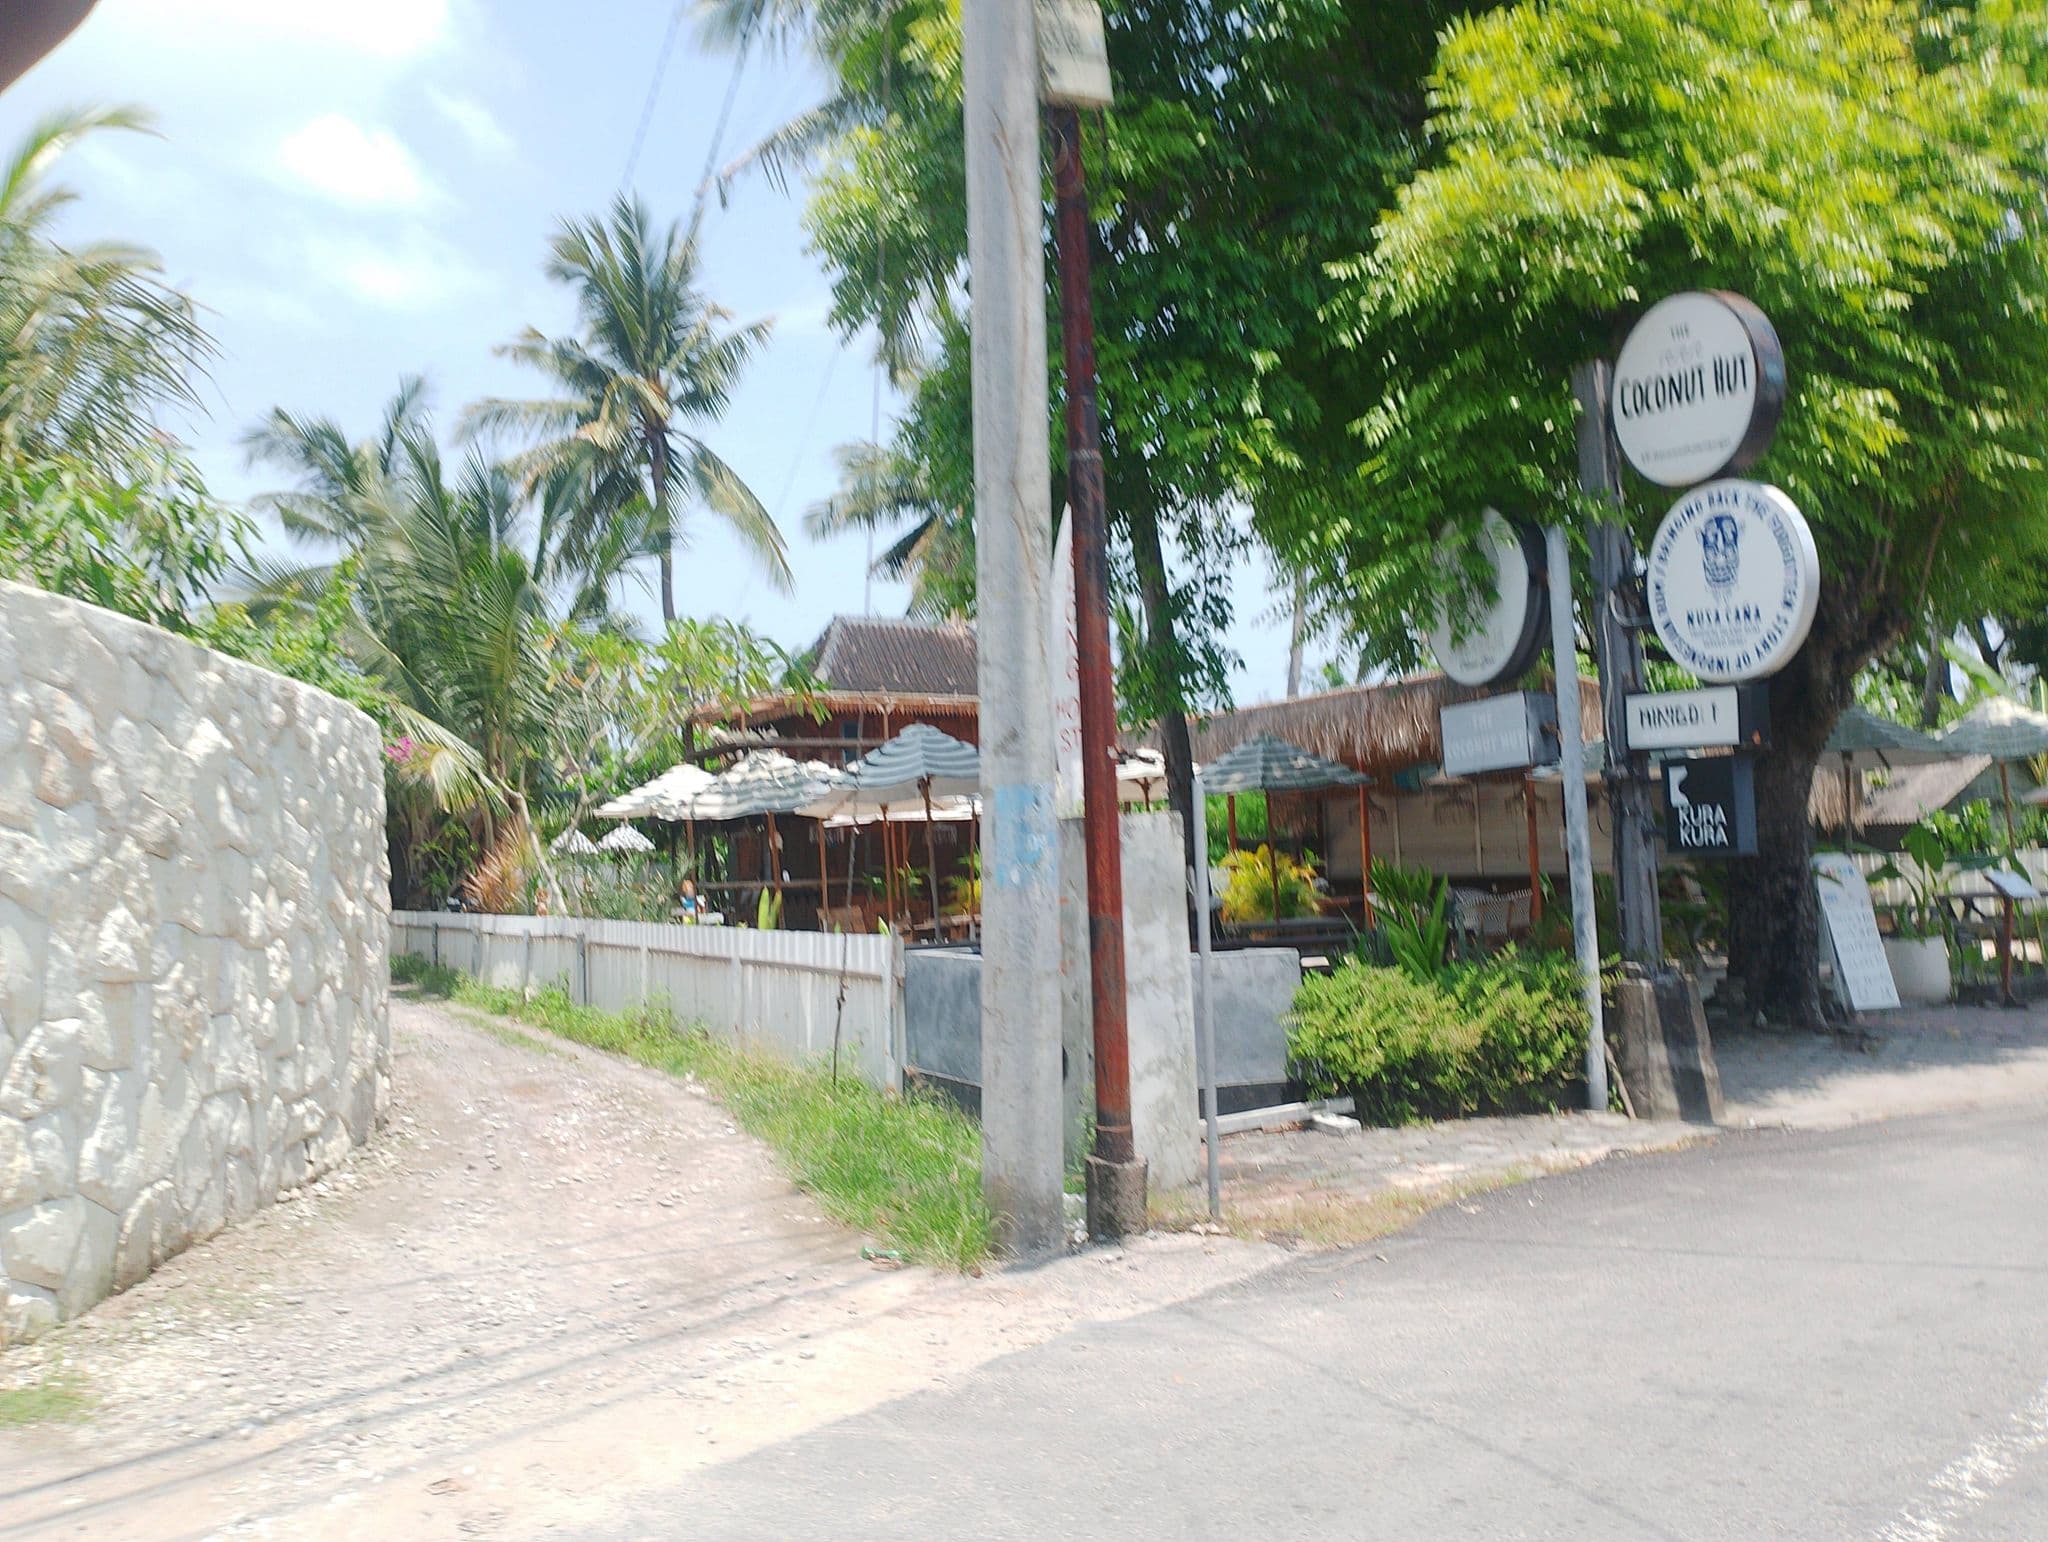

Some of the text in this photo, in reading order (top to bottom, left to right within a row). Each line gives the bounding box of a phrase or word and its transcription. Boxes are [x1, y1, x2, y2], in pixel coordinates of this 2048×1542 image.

[1620, 366, 1705, 419] COCONUT
[1713, 351, 1749, 397] HUT
[1679, 803, 1727, 826] KURA
[1680, 824, 1729, 848] KURA
